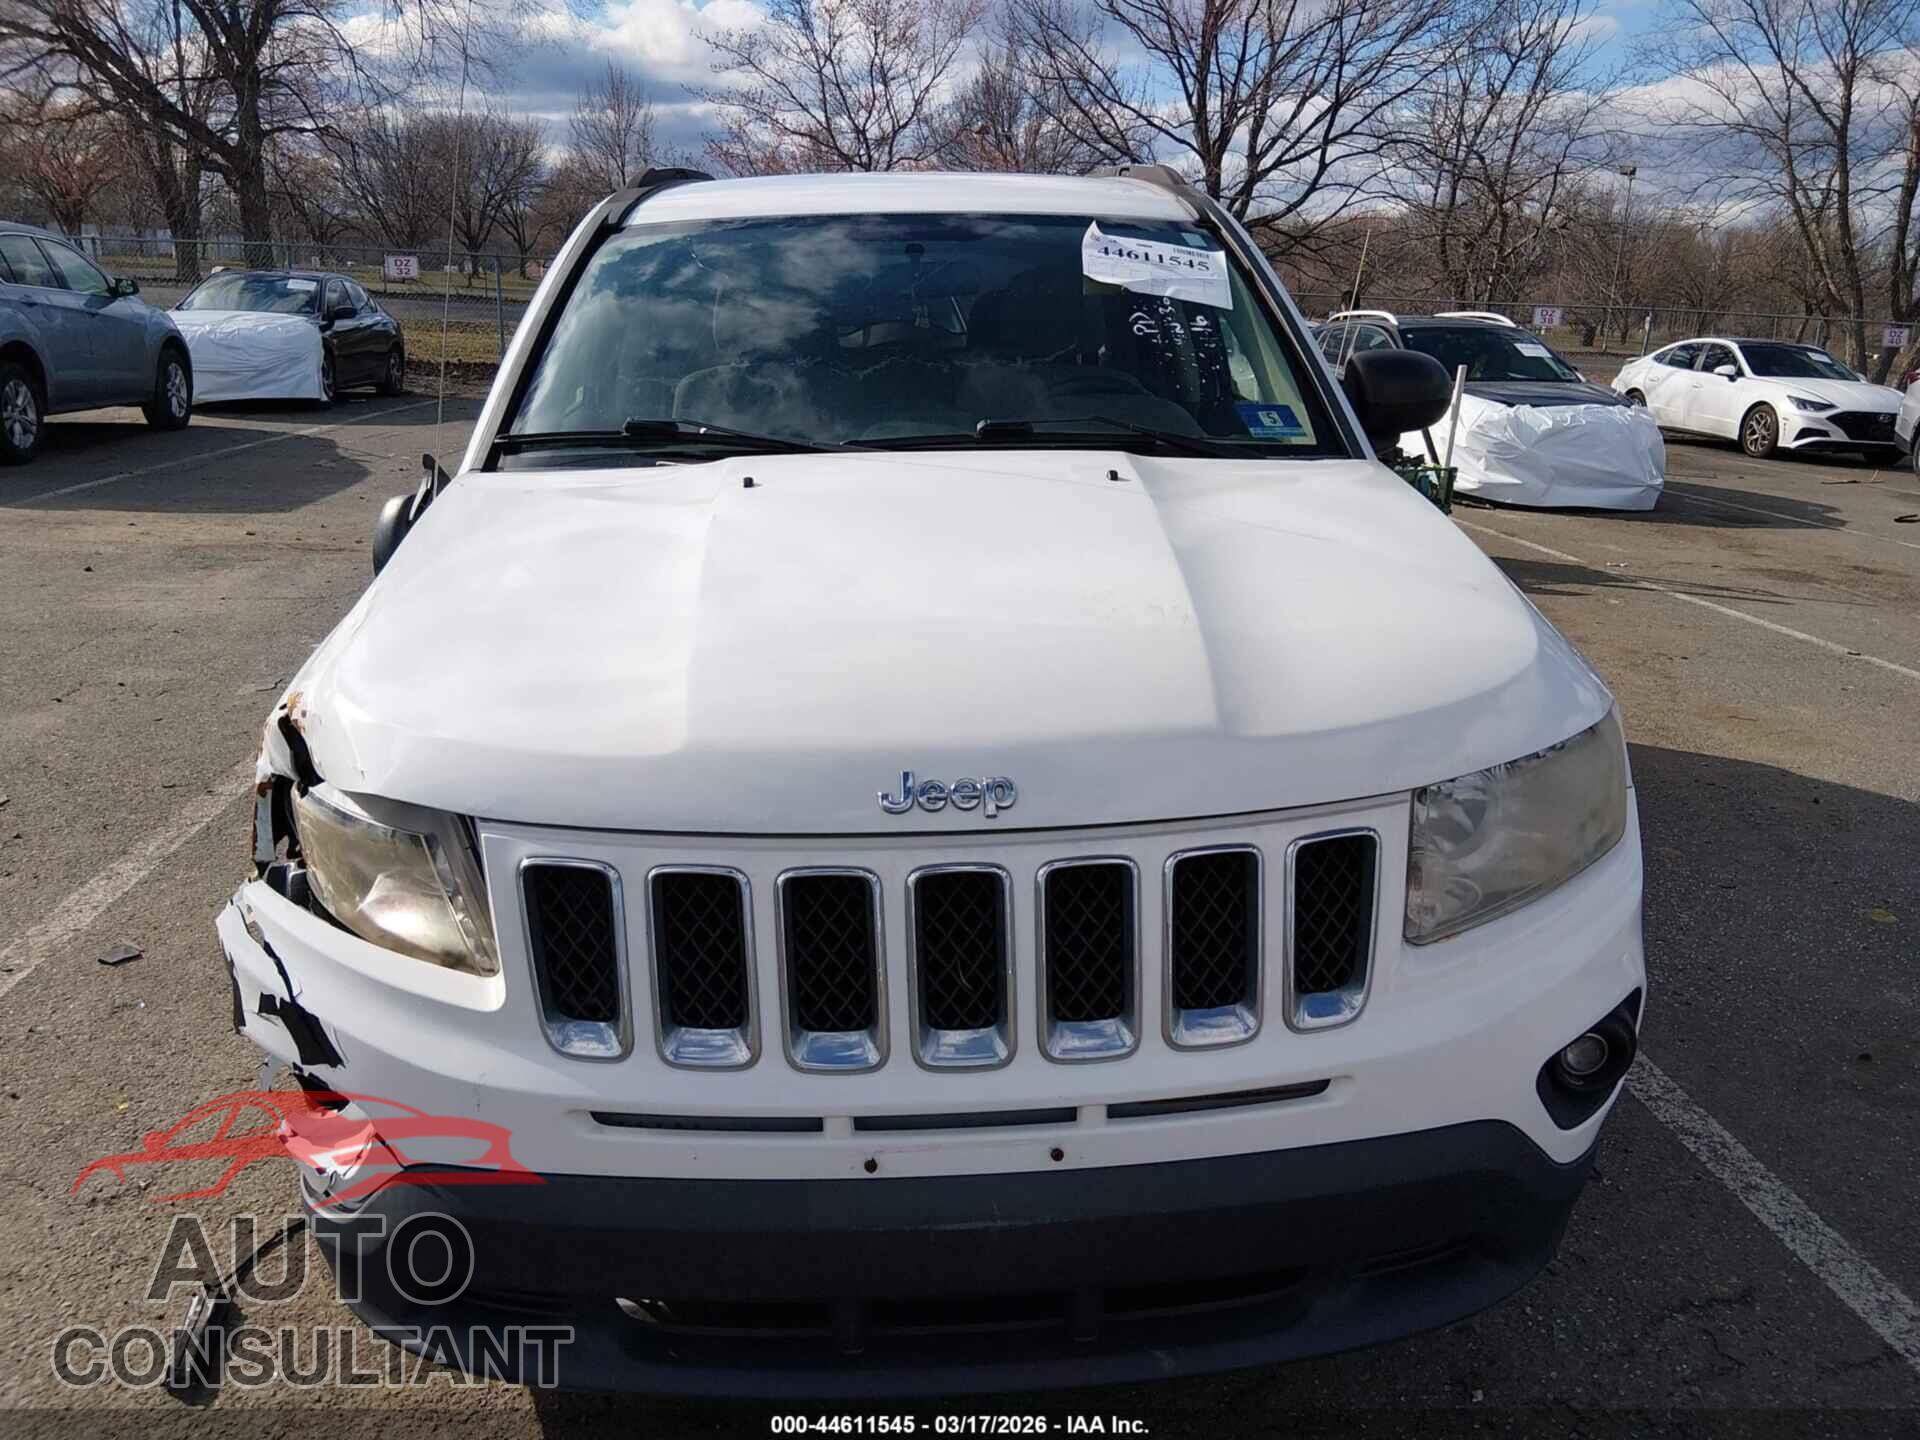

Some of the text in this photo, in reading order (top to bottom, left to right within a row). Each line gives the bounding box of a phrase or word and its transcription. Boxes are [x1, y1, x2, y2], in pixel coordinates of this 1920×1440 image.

[394, 258, 411, 267] DZ
[1097, 246, 1210, 271] 44611545
[395, 267, 411, 275] 32
[877, 771, 1017, 819] Jeep
